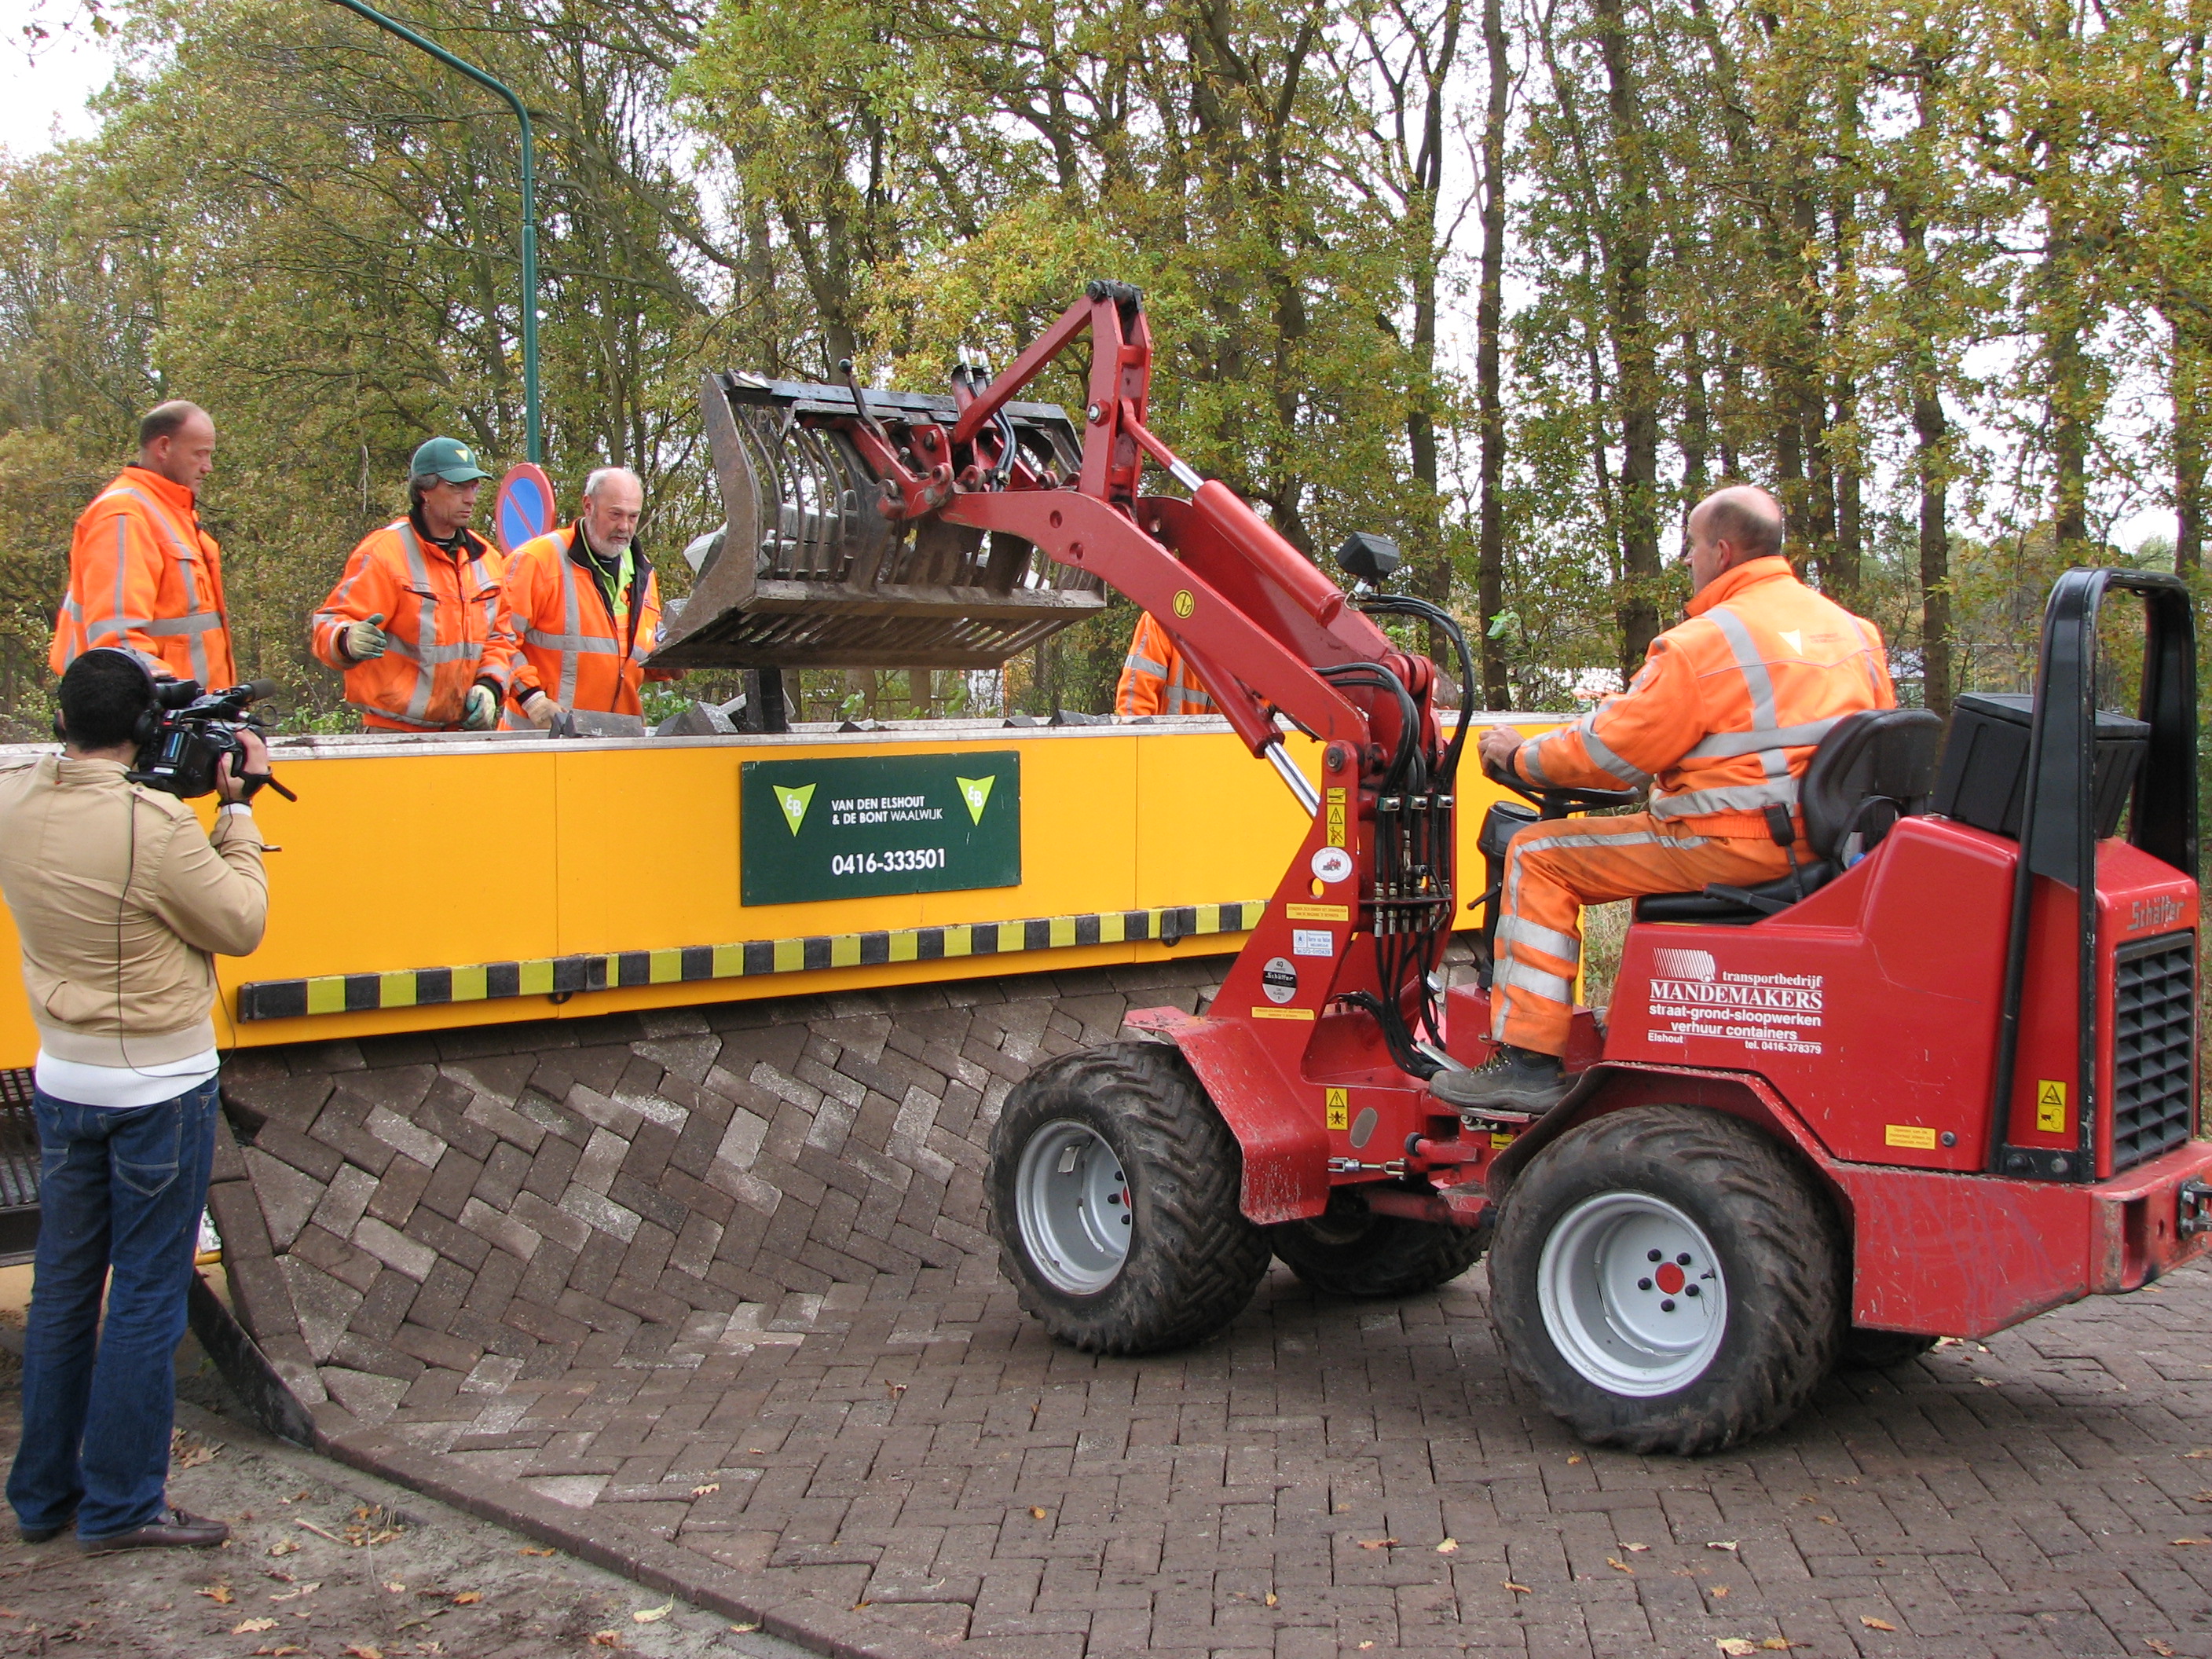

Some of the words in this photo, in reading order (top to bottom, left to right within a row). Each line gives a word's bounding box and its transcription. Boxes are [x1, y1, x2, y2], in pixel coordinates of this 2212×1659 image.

[832, 800, 854, 811] VAN
[857, 797, 878, 810] DEN
[881, 796, 925, 808] ELSHOUT
[832, 814, 840, 825] &
[843, 812, 856, 824] DE
[859, 811, 888, 823] BONT
[890, 808, 943, 821] WAALWIJK
[832, 848, 945, 875] 0416-333501
[1723, 971, 1822, 989] transportbedrijf
[1650, 981, 1822, 1009] MANDEMAKERS
[1649, 1003, 1822, 1027] straat-grond-sloopwerken
[1647, 1032, 1684, 1044] Elshout
[1670, 1020, 1723, 1035] verhuur
[1725, 1025, 1798, 1041] containers
[1745, 1040, 1760, 1050] tel.
[1761, 1041, 1822, 1055] 0416-378379
